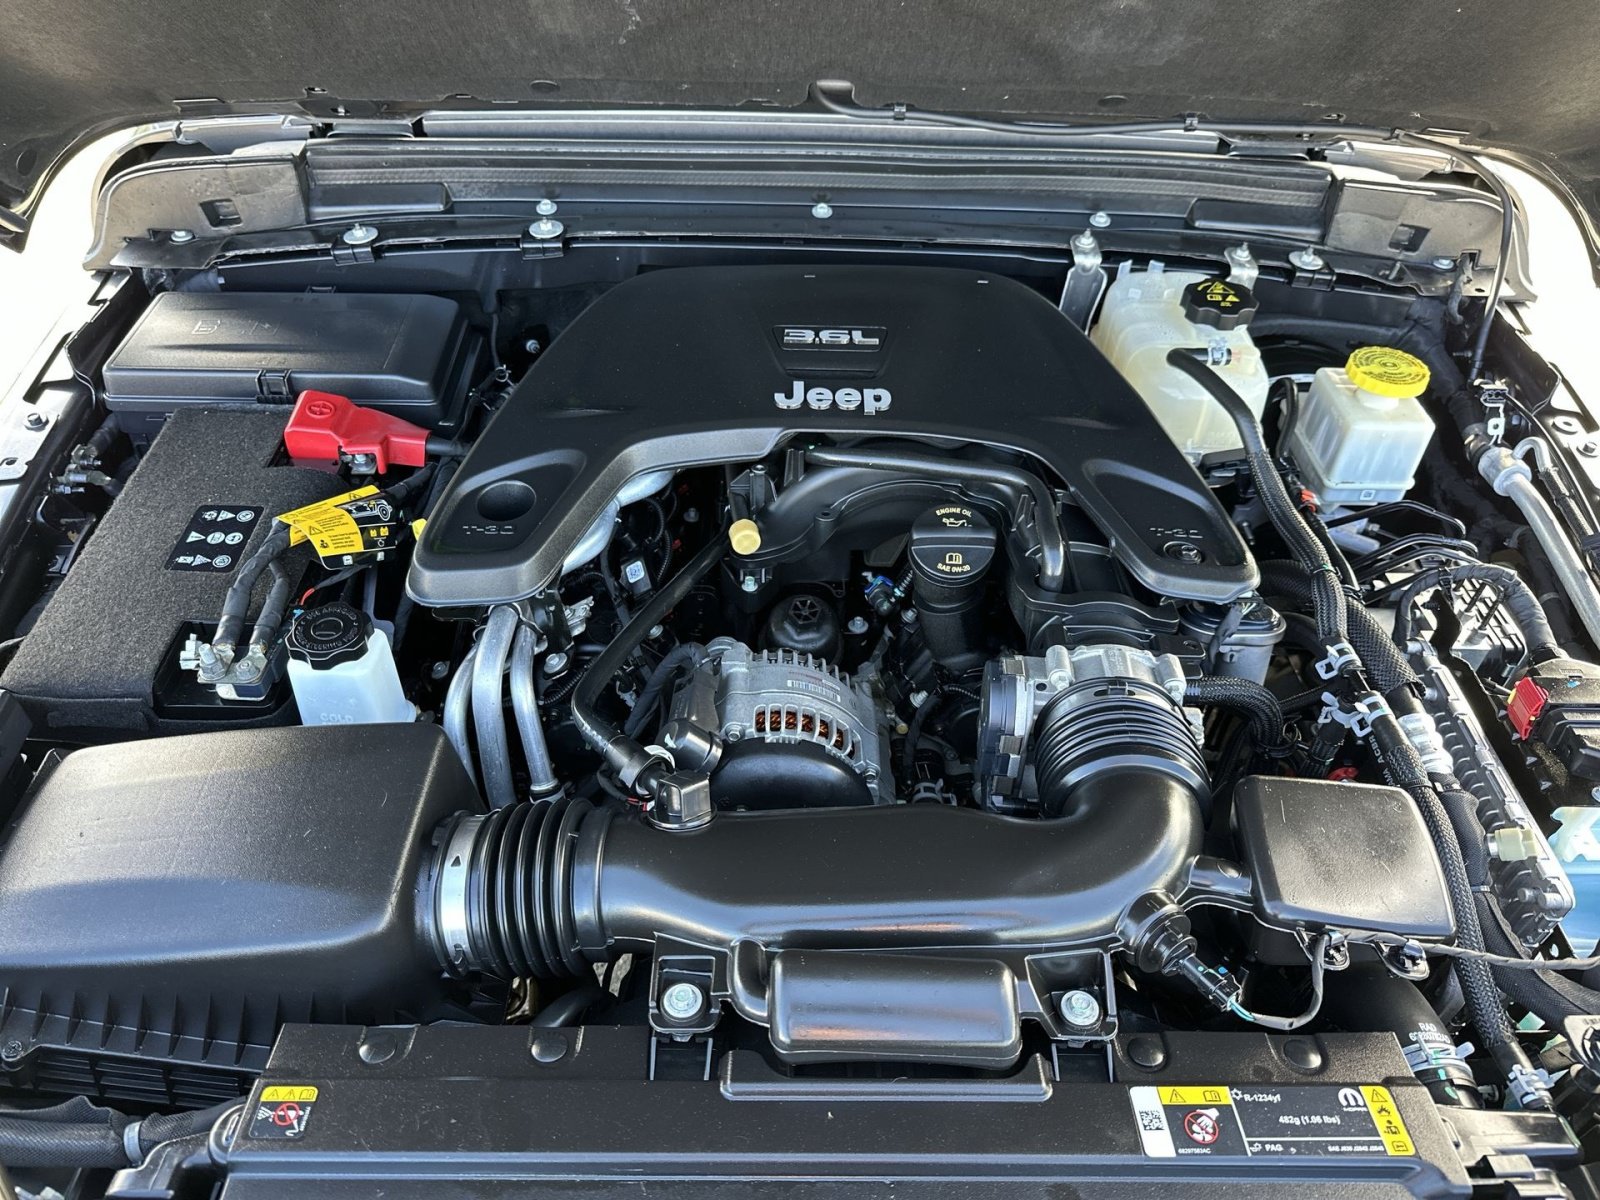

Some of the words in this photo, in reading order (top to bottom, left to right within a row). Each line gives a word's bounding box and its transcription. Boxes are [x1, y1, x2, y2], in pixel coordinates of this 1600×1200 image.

[783, 328, 880, 345] 3.6L
[773, 380, 892, 416] Jeep
[935, 507, 961, 516] ENGINE
[962, 508, 972, 518] OIL
[937, 563, 951, 573] SAE
[1278, 1115, 1301, 1126] 482g
[1264, 1144, 1284, 1152] PAG
